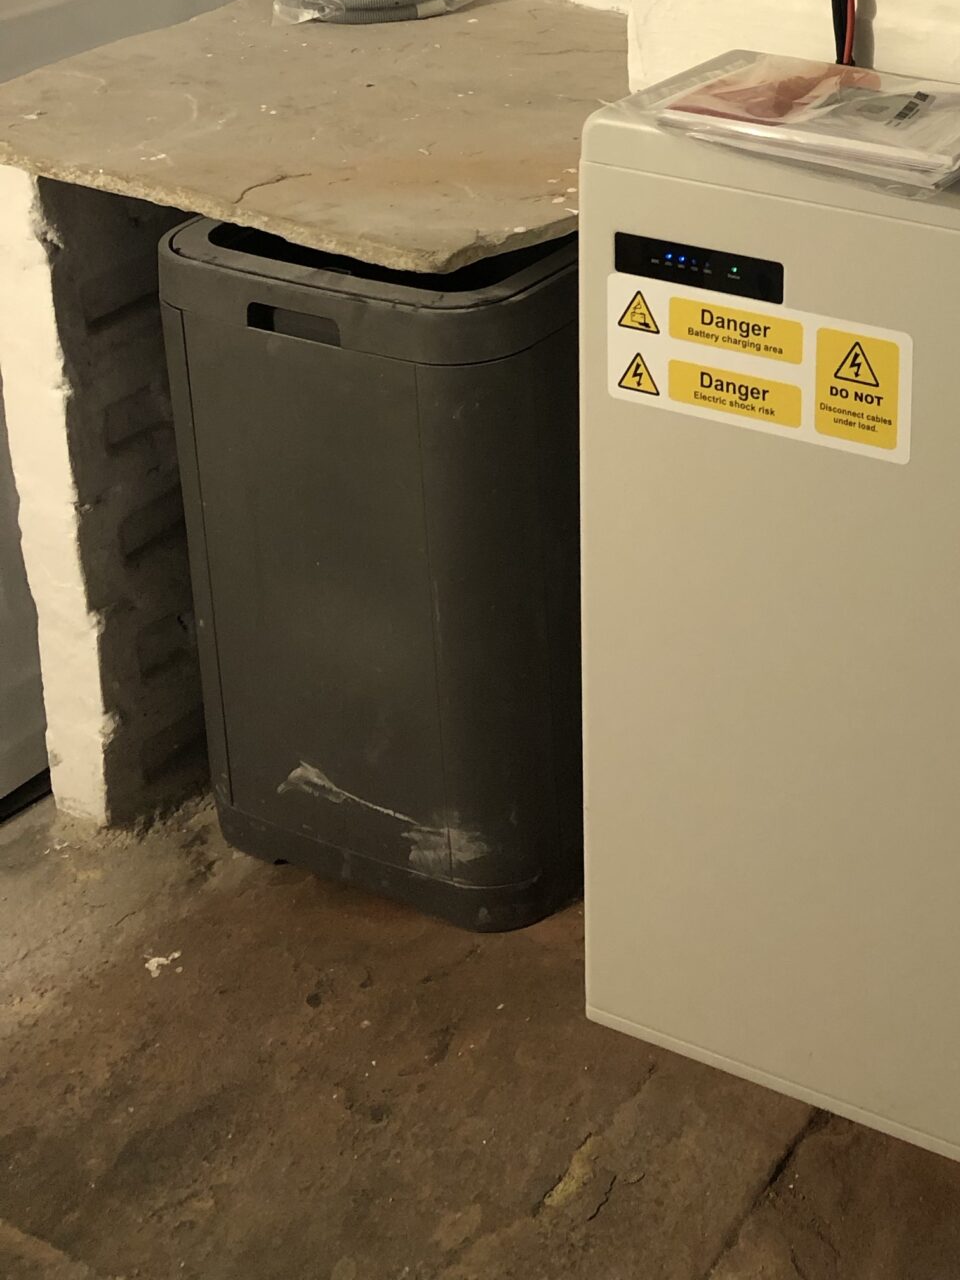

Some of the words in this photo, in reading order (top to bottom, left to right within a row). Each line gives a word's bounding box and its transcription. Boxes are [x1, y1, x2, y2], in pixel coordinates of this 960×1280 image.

[700, 308, 771, 338] Danger
[687, 327, 719, 344] Battery
[721, 334, 761, 352] charging
[763, 345, 783, 355] area
[700, 371, 770, 402] Danger
[829, 386, 849, 399] DO
[853, 390, 884, 406] NOT
[693, 391, 727, 407] Electric
[729, 398, 756, 412] shock
[758, 405, 776, 417] risk
[819, 402, 864, 419] Disconnect
[866, 412, 893, 426] cables
[833, 417, 856, 429] under
[857, 421, 878, 432] load.
